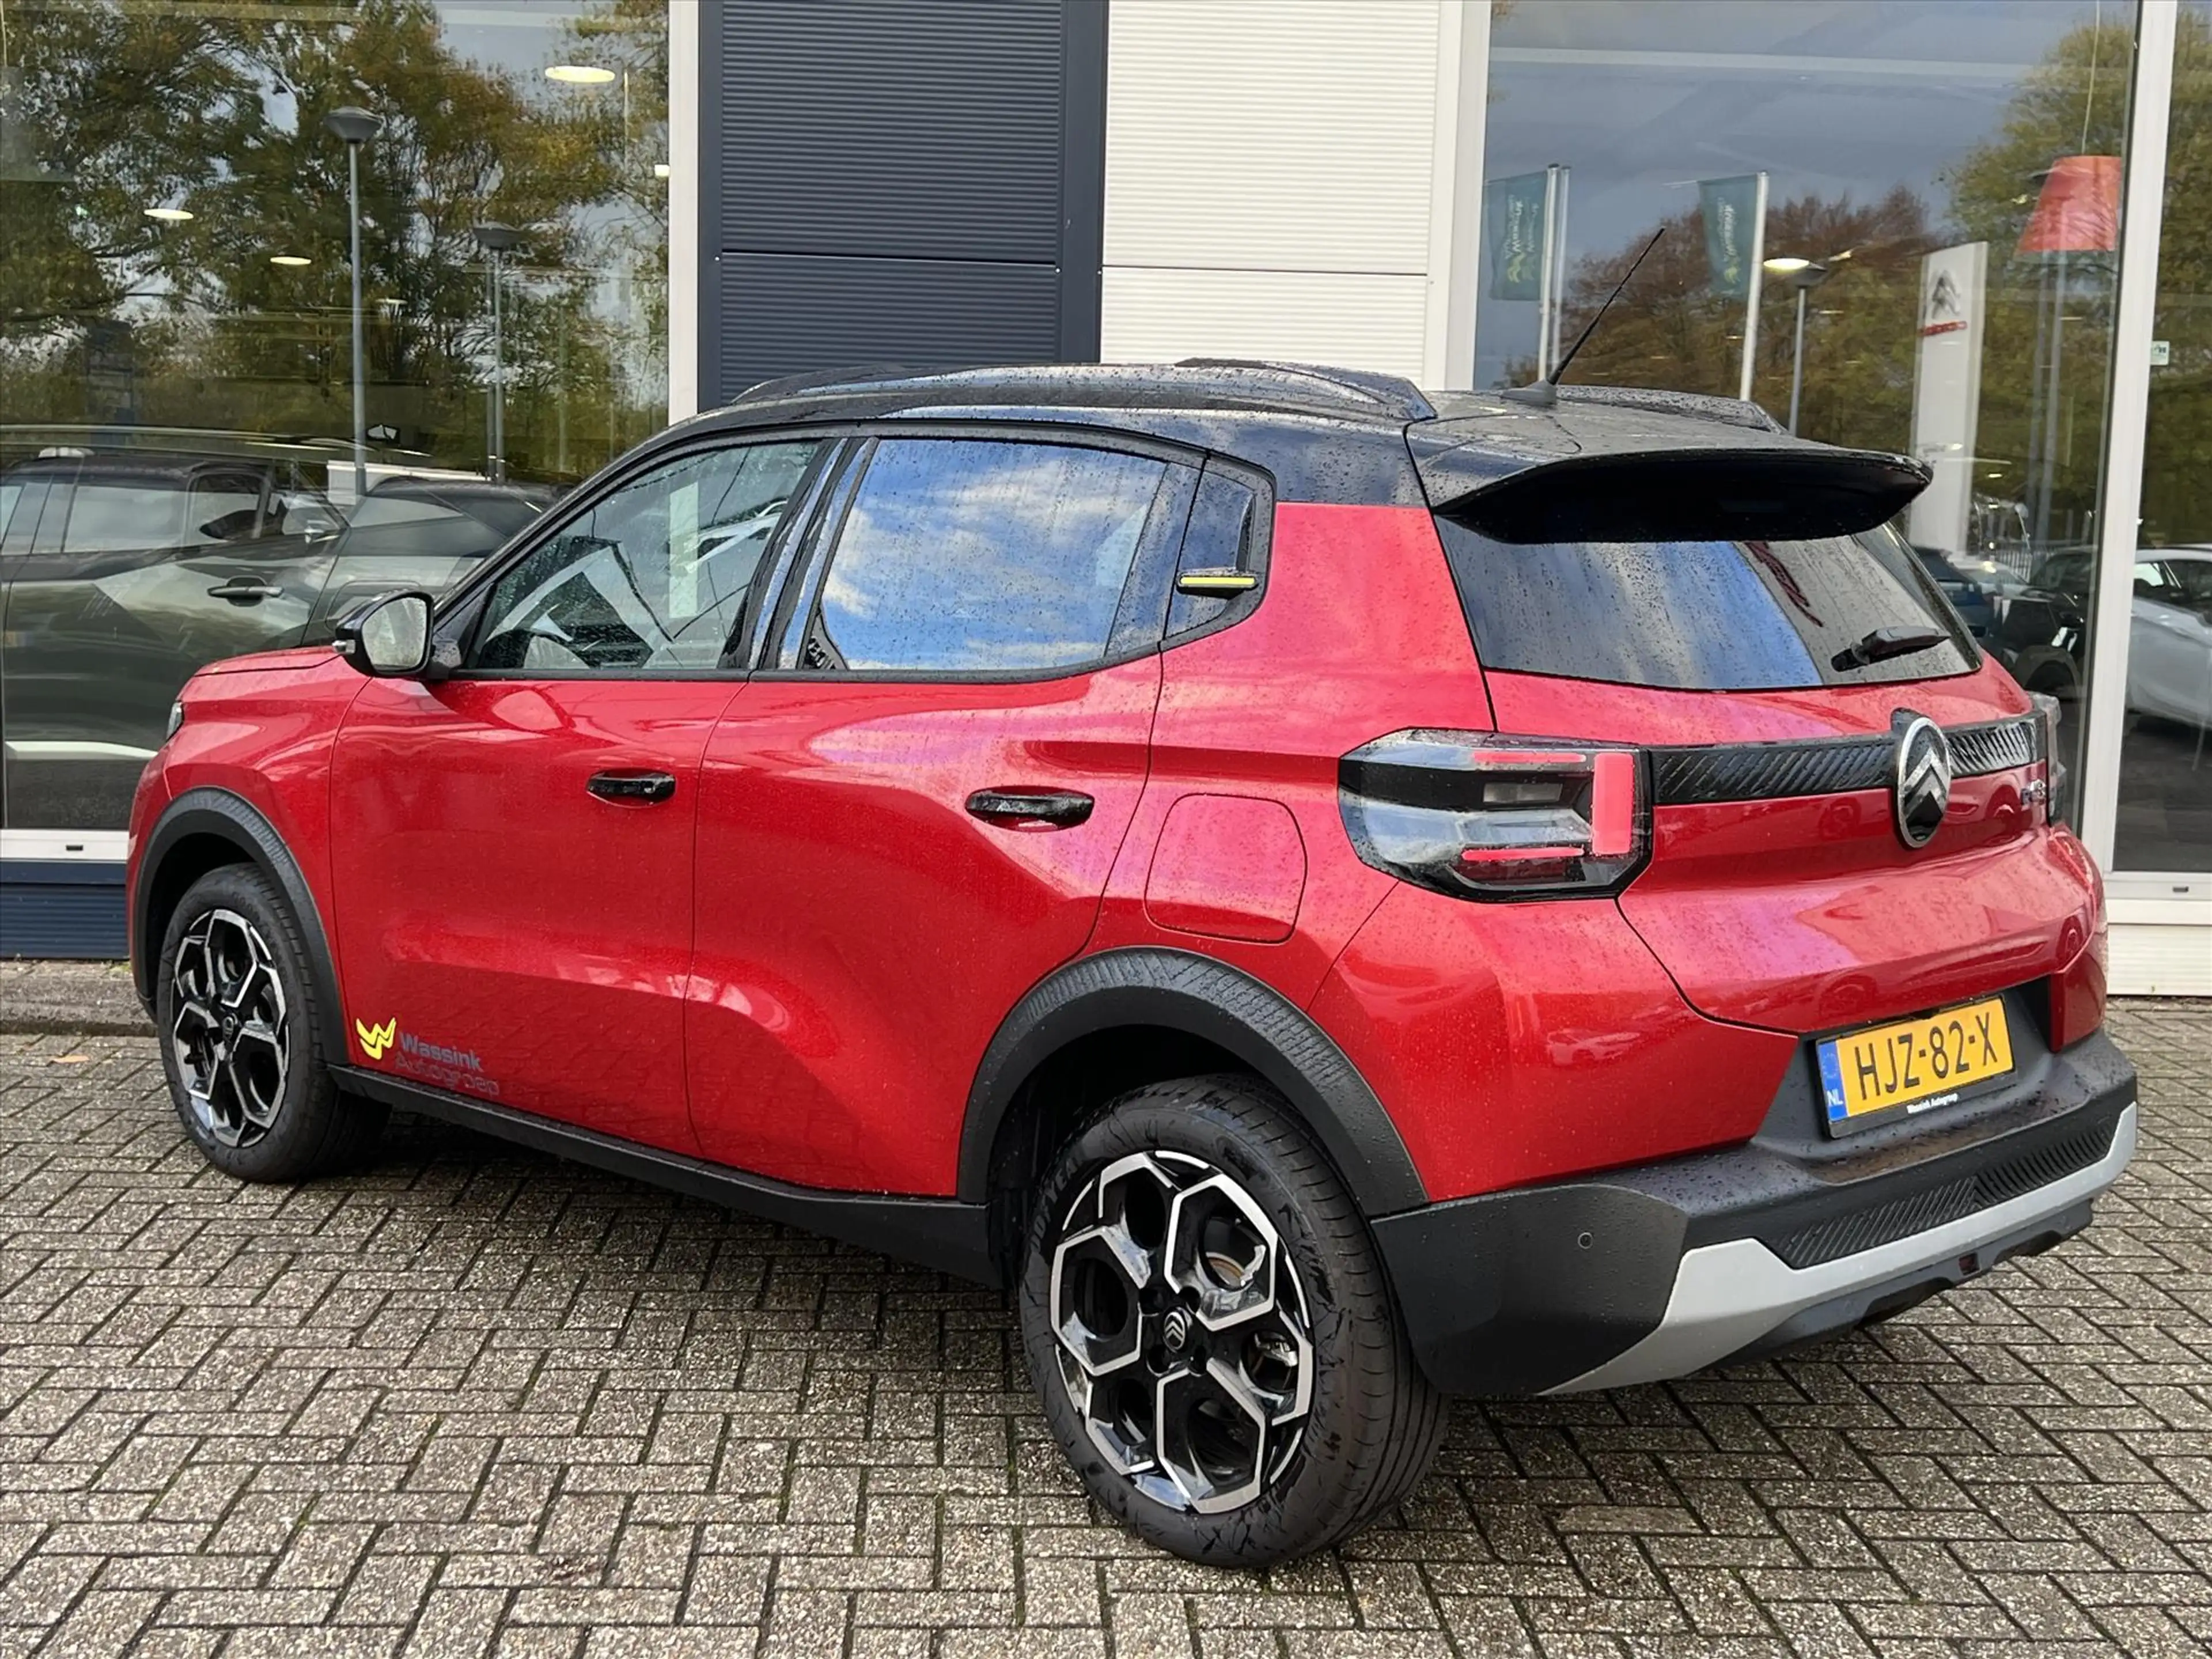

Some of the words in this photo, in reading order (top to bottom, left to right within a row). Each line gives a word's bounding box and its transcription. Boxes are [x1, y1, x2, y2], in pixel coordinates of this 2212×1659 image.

[400, 1031, 484, 1073] Wassink
[1854, 1012, 1998, 1100] HJZ-82-X
[1827, 1090, 1843, 1107] NL
